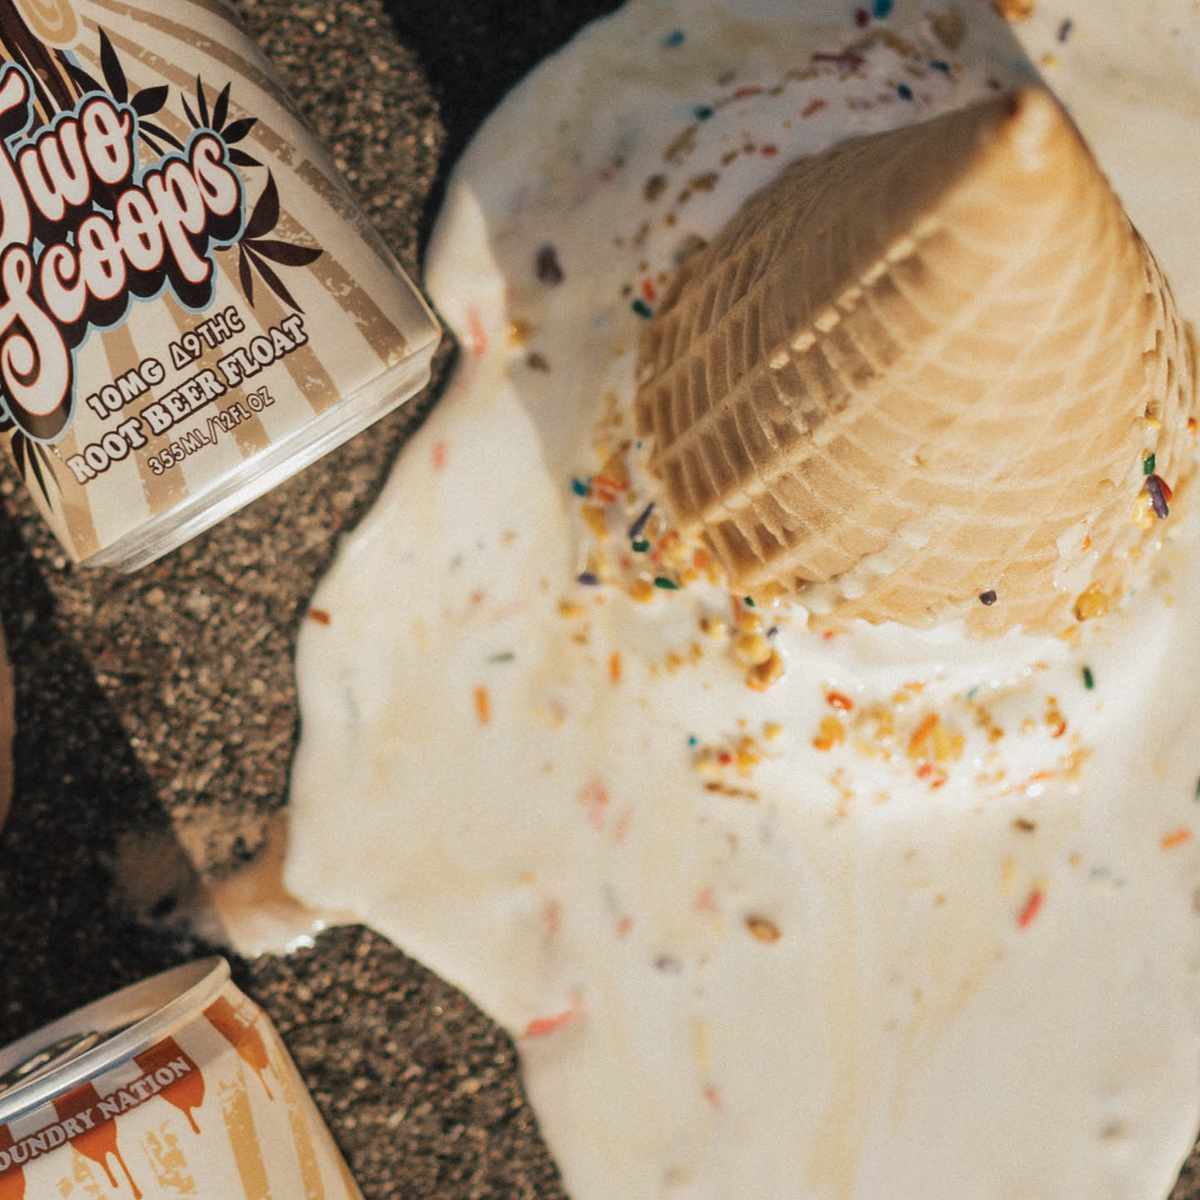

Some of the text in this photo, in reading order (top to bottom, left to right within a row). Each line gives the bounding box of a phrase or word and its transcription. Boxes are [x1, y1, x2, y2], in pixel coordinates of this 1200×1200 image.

[66, 314, 308, 485] ROOT BEER FLOAT
[86, 358, 165, 419] 10MG
[246, 386, 275, 412] OZ
[98, 1055, 192, 1120] NATION
